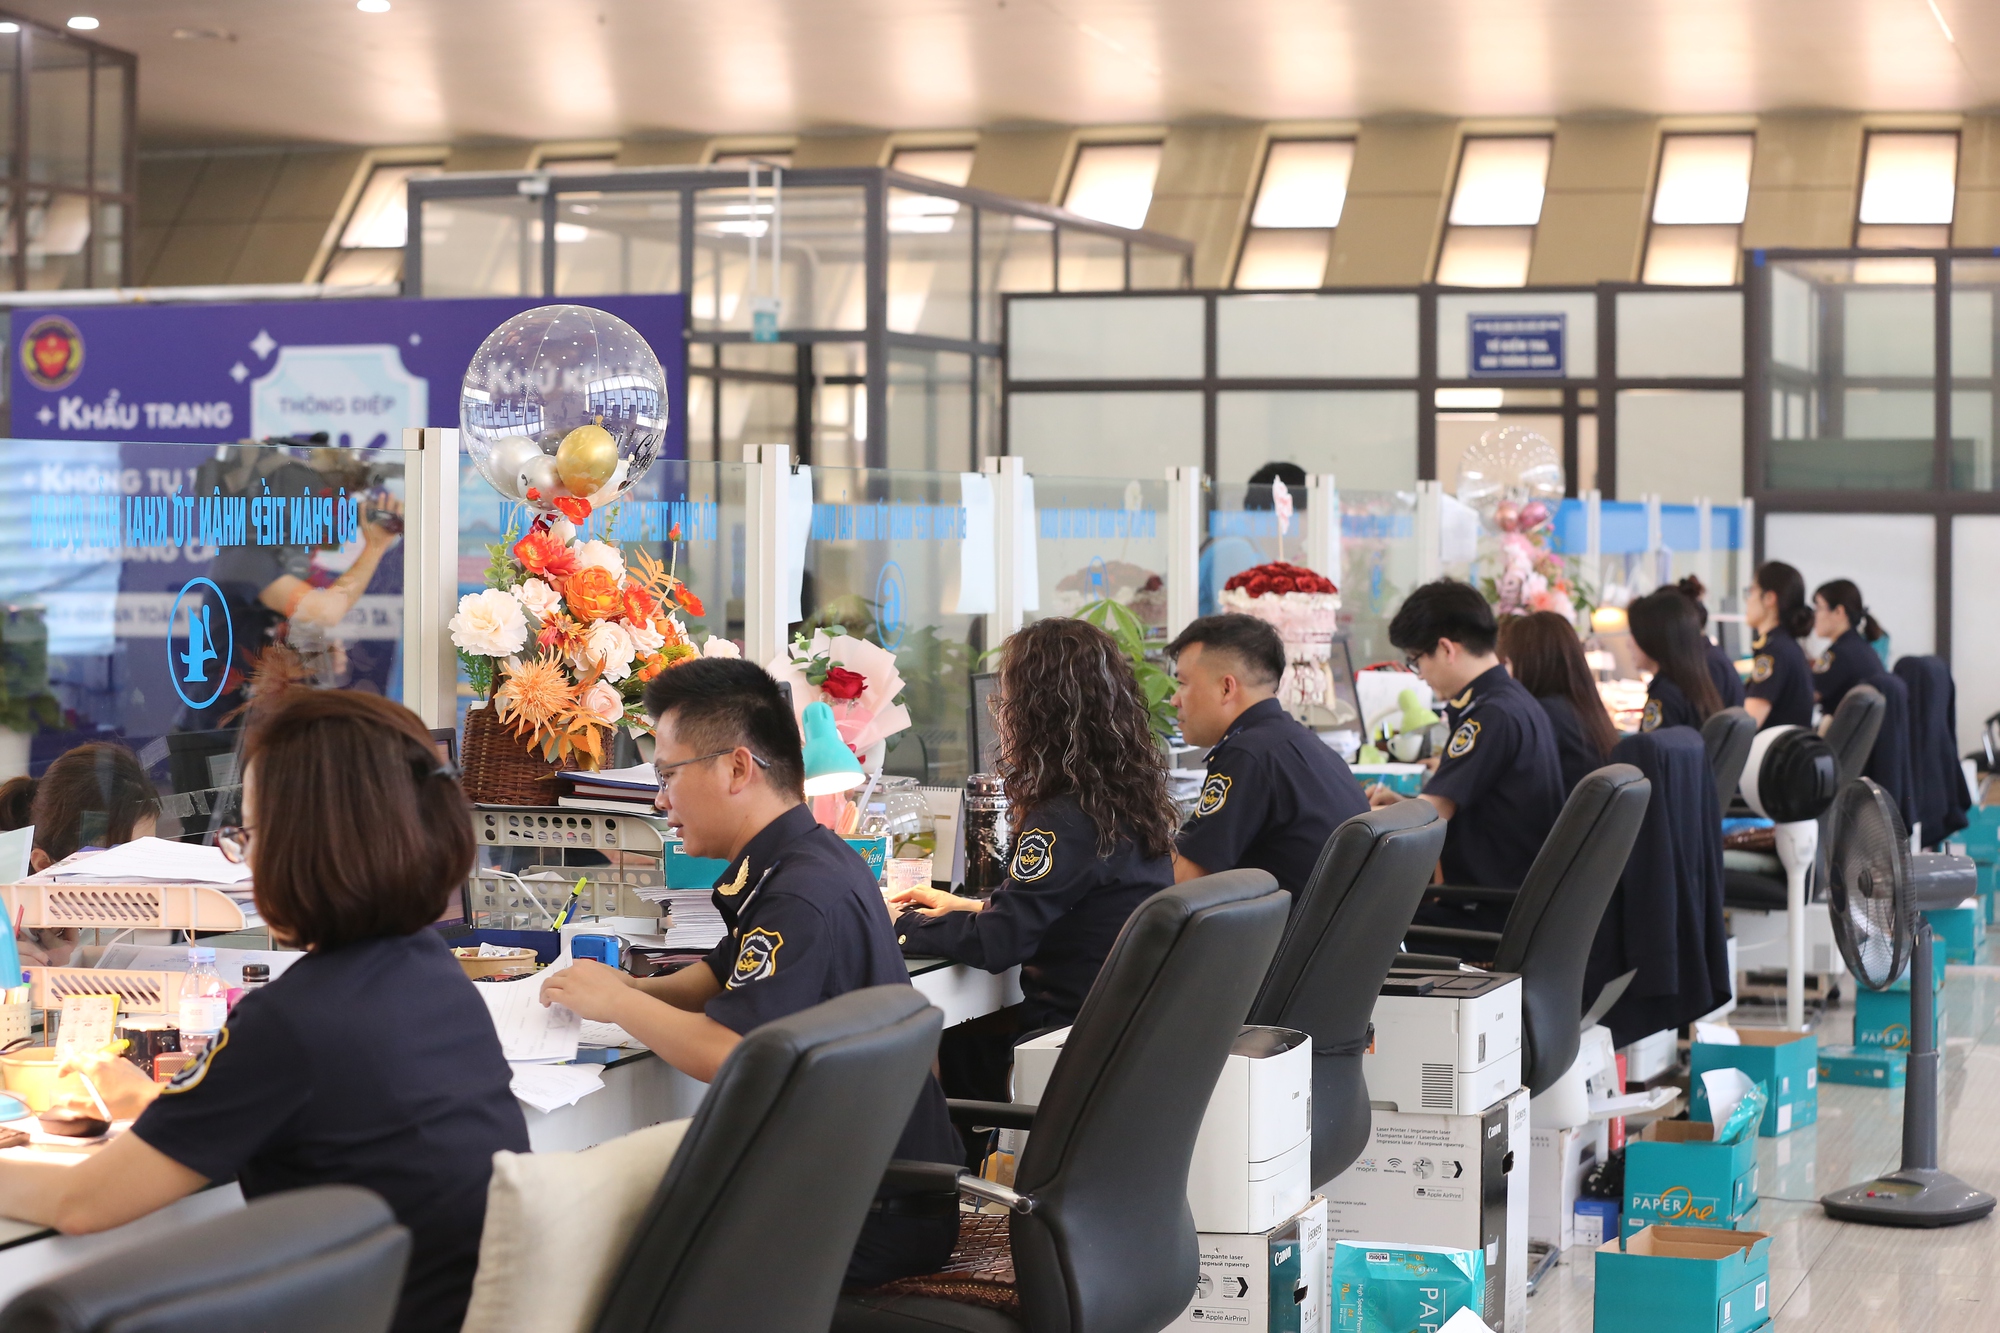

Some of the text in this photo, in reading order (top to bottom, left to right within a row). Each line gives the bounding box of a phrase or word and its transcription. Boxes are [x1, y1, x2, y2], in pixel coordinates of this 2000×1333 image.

[143, 401, 233, 429] TRANG
[1488, 1123, 1501, 1139] Canon
[1274, 1246, 1292, 1266] Canon
[1356, 1298, 1364, 1315] Speed
[1206, 1313, 1247, 1322] Apple AirPrint
